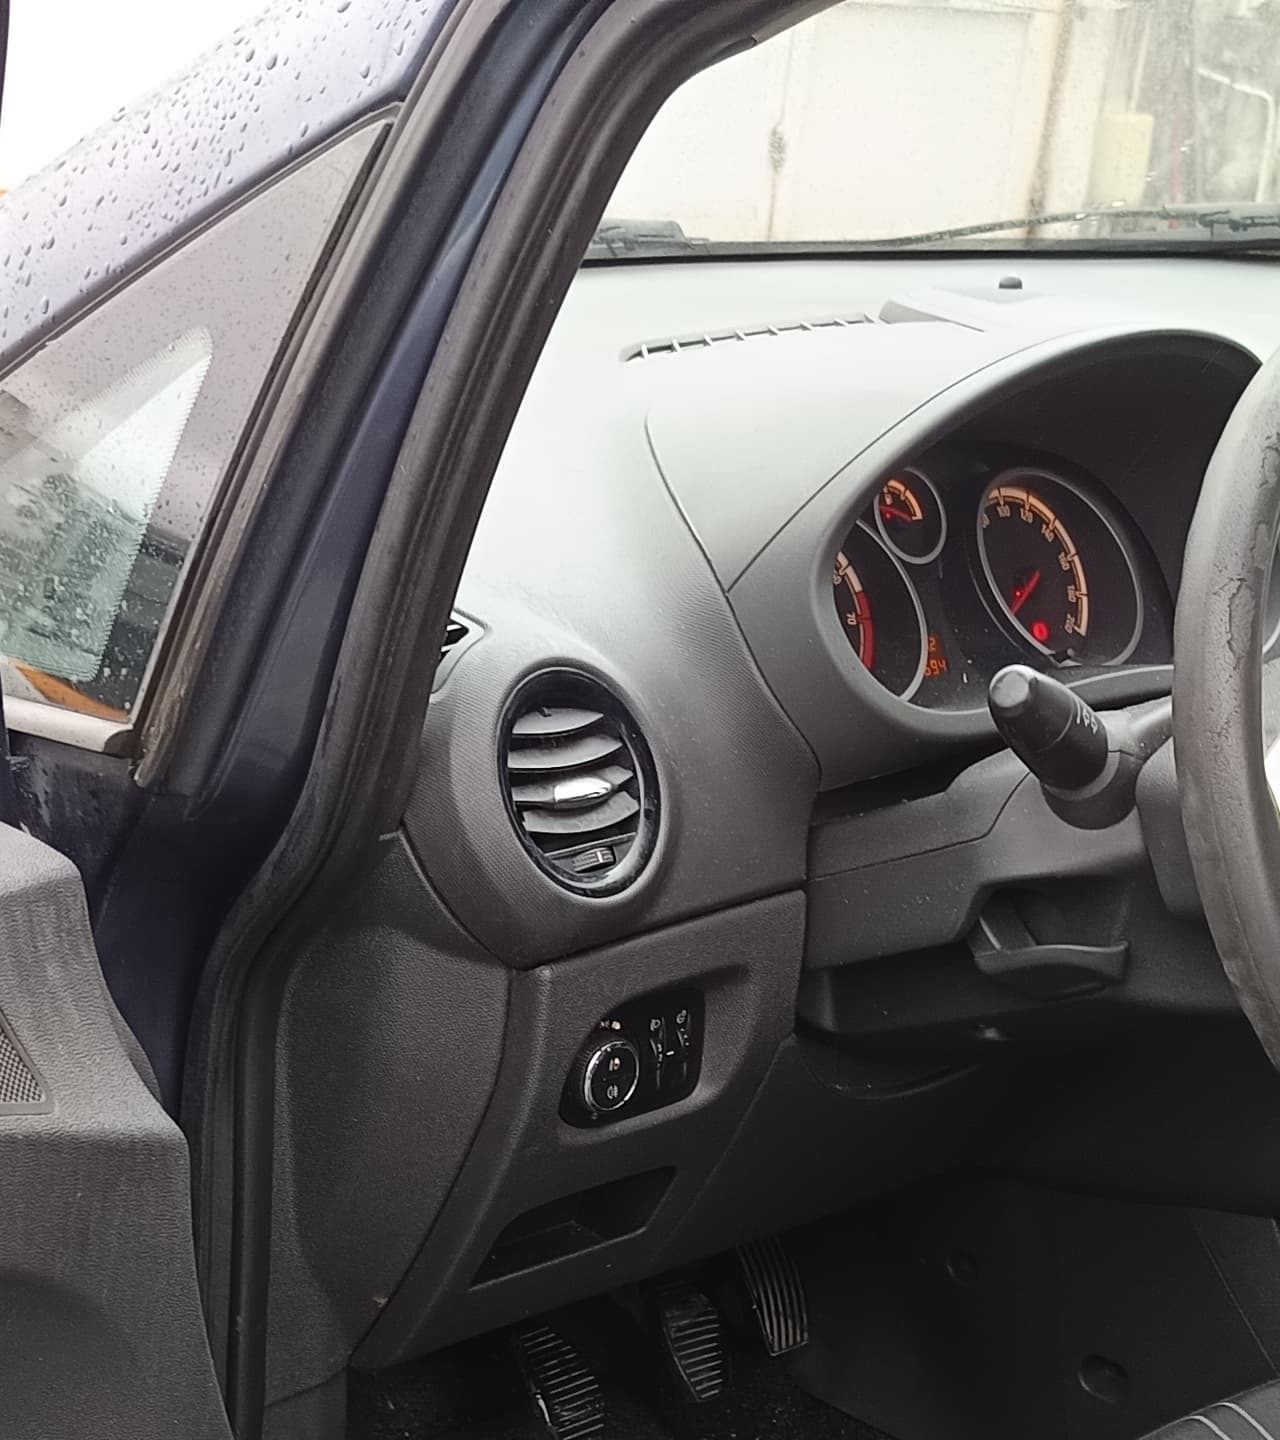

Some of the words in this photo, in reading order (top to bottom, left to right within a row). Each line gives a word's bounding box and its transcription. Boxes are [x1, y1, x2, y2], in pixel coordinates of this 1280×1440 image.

[996, 504, 1011, 518] 100
[1020, 507, 1034, 524] 120
[1041, 523, 1055, 543] 140
[846, 611, 857, 626] 70
[1064, 613, 1076, 634] 200
